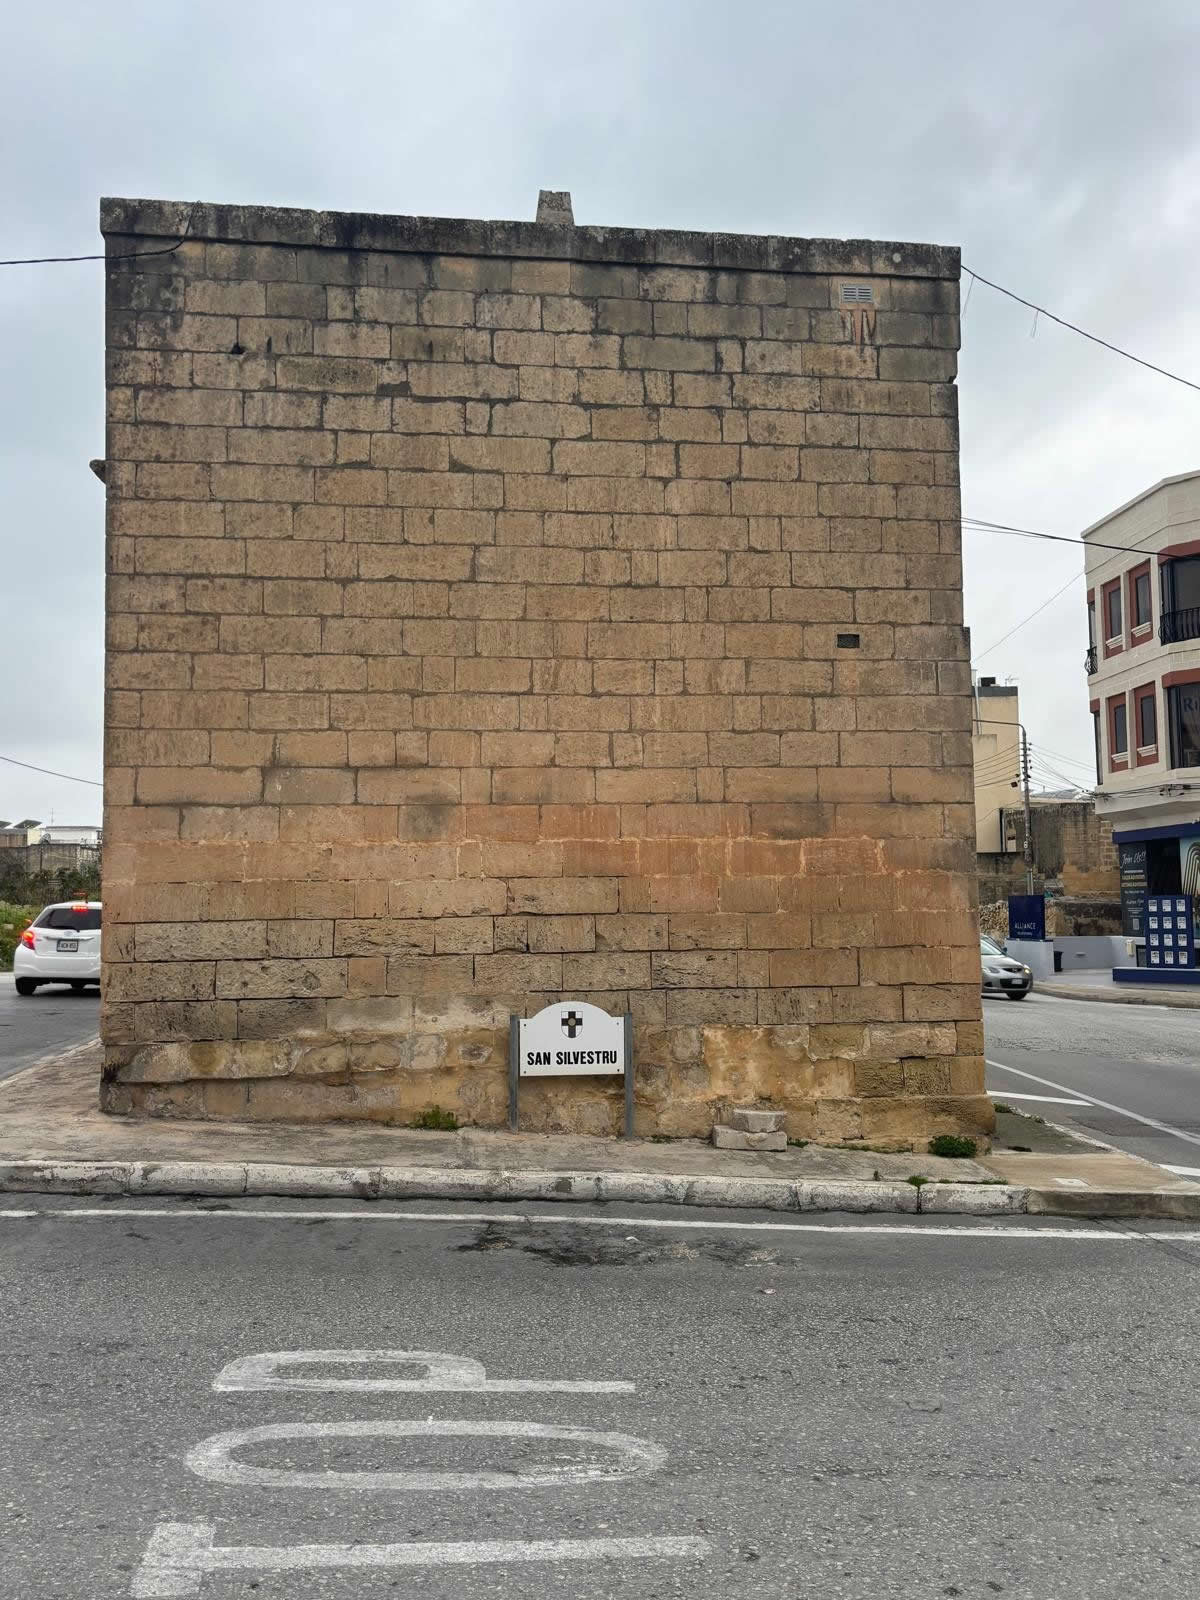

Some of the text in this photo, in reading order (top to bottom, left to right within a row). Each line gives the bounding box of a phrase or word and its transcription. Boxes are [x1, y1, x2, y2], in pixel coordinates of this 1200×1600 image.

[1014, 922, 1036, 930] ALLIANCE
[527, 1050, 617, 1065] SAN SILVESTRU
